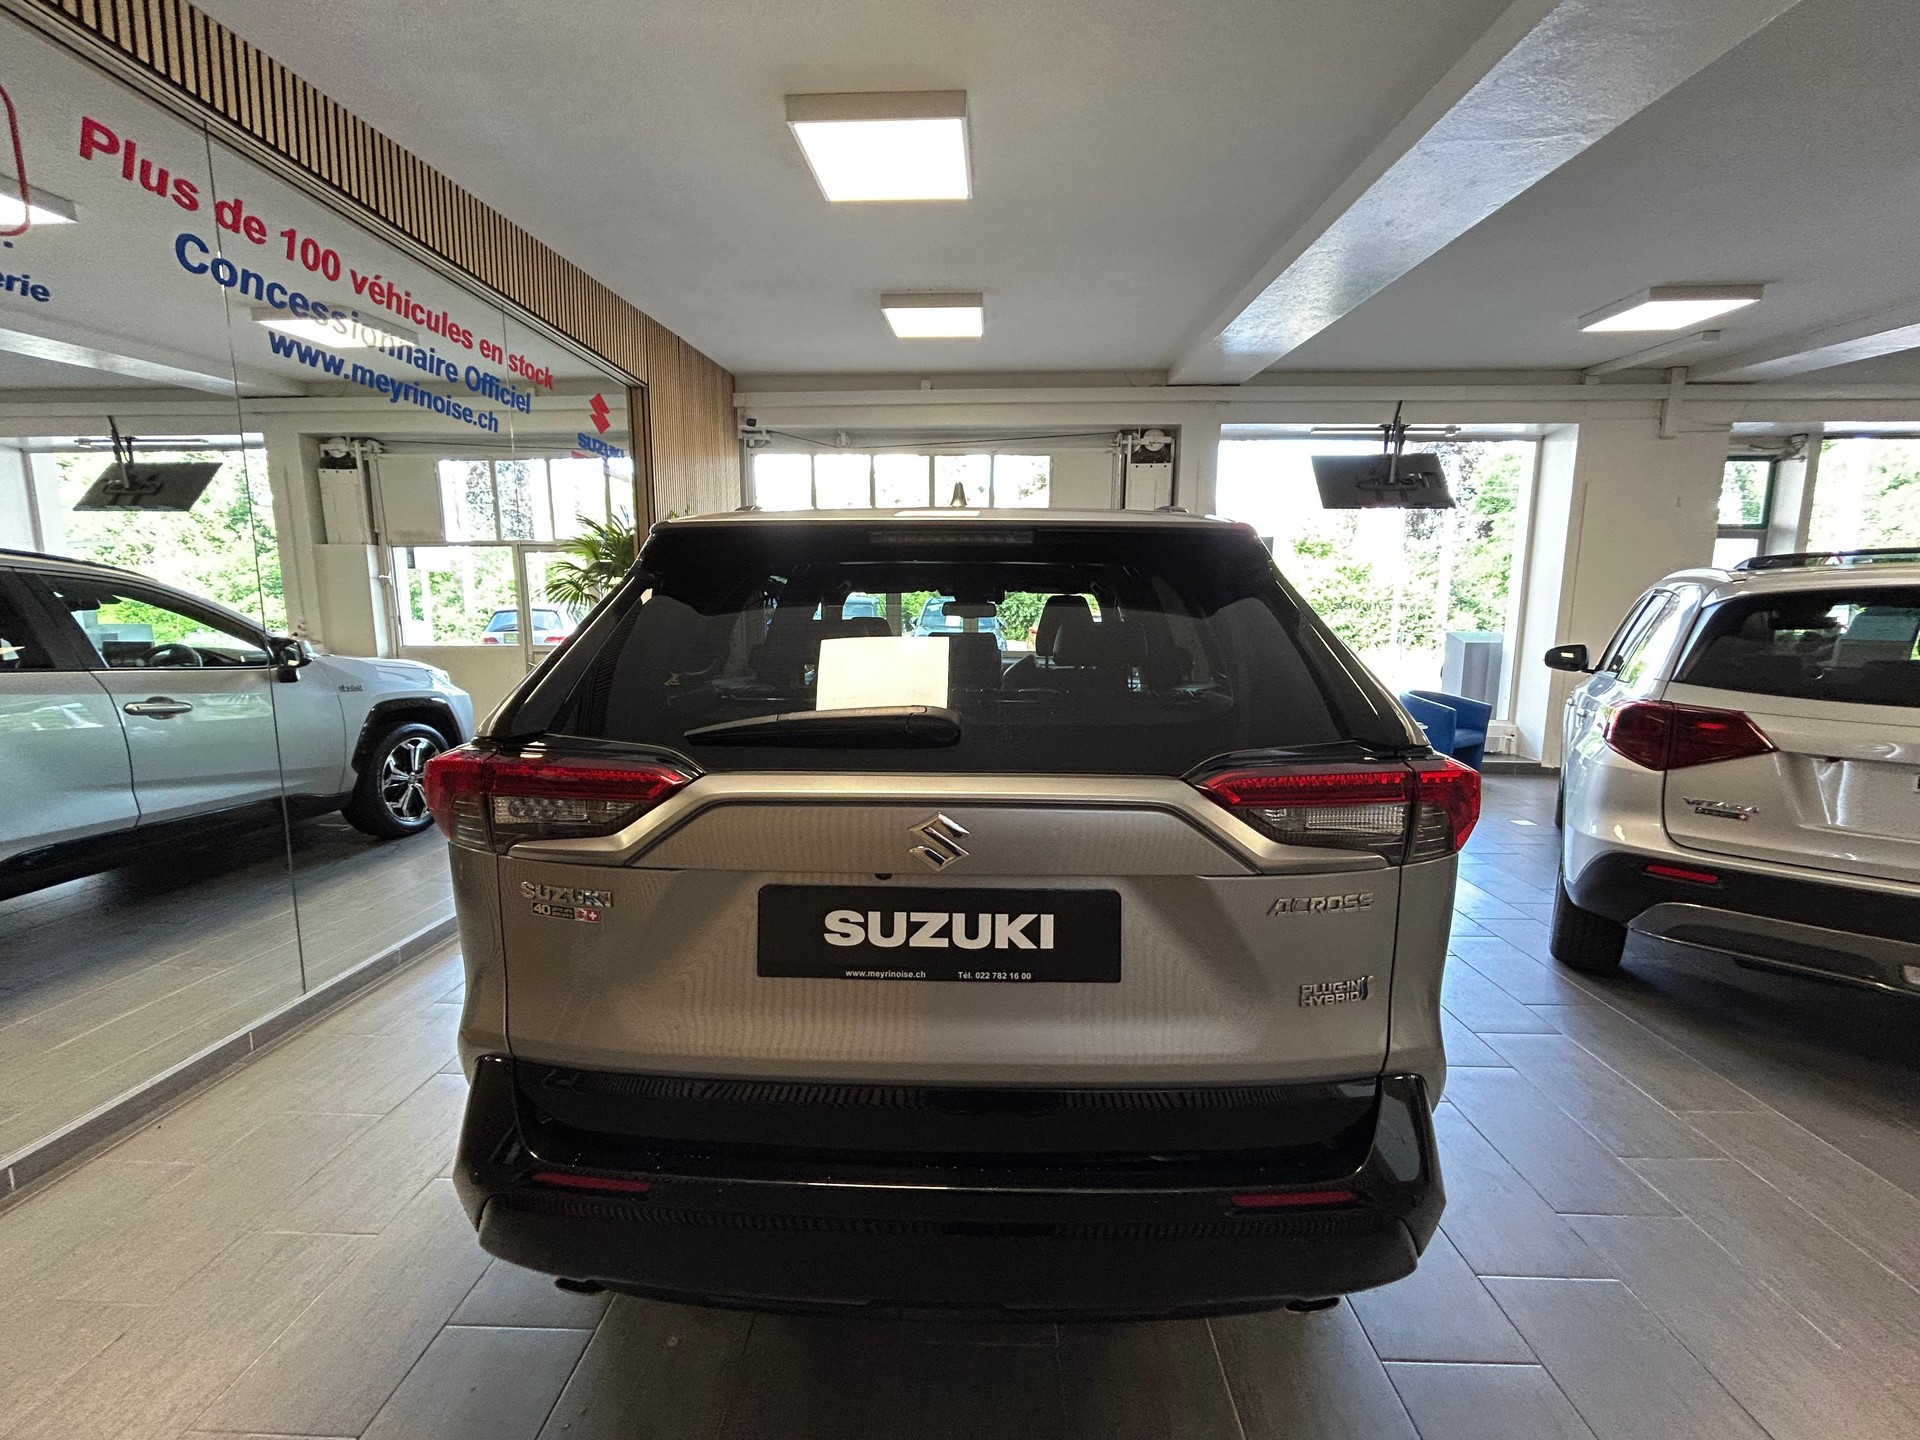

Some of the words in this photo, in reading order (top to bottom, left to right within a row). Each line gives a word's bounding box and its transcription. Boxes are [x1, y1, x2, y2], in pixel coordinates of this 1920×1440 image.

[79, 116, 200, 212] Plus
[215, 198, 267, 245] de
[280, 228, 341, 282] 100
[350, 268, 474, 350] véhicules
[479, 338, 504, 365] en
[508, 353, 554, 390] stock
[0, 272, 51, 303] rie
[175, 232, 459, 383] Concessionnaire
[465, 365, 531, 415] Officiel
[268, 330, 499, 433] www.meyrinoise.ch
[520, 881, 613, 908] SUZUKI
[1266, 892, 1374, 916] ACROSS
[533, 903, 551, 916] 40
[823, 909, 1055, 950] SUZUKI
[845, 969, 926, 979] www.meyrinoise.ch
[975, 971, 991, 980] 022
[992, 971, 1008, 980] 782
[1009, 971, 1020, 980] 16
[1021, 971, 1032, 980] 00
[1300, 991, 1361, 1007] HYBRID
